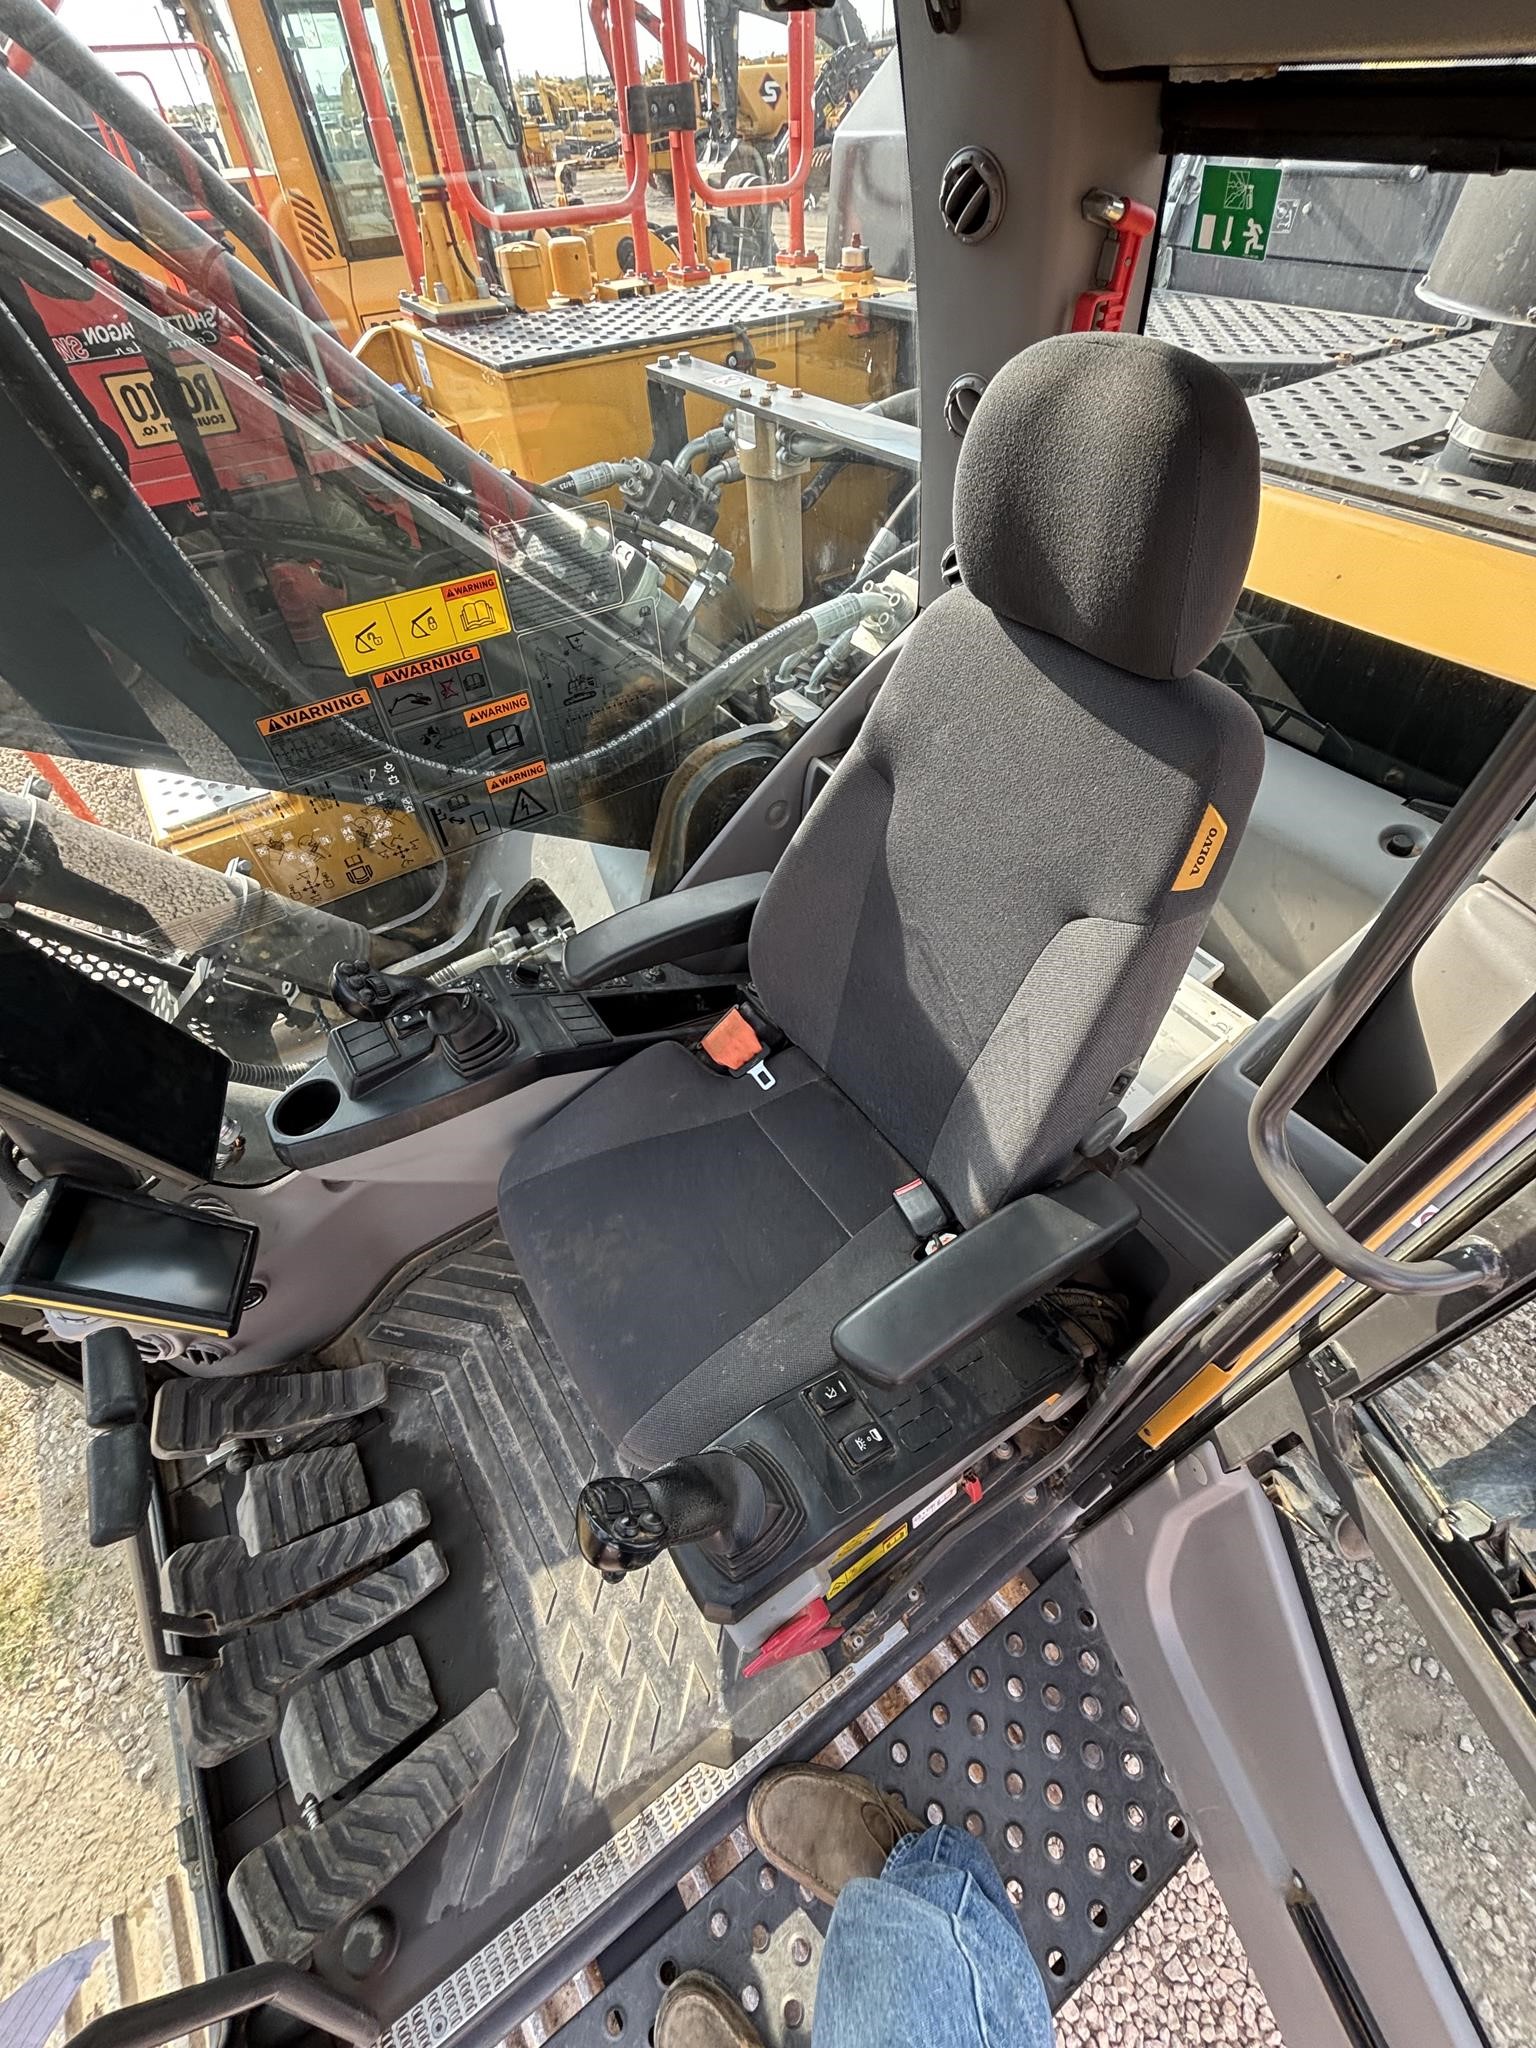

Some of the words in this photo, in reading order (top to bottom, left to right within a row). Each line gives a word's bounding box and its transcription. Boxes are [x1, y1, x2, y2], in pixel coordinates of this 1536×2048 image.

[454, 579, 495, 595] WARNING
[392, 649, 474, 681] WARNING
[719, 639, 758, 670] VOLVO
[280, 693, 365, 727] WARNING
[477, 697, 528, 721] WARNING
[499, 764, 544, 787] WARNING
[1190, 827, 1218, 877] VOLVO
